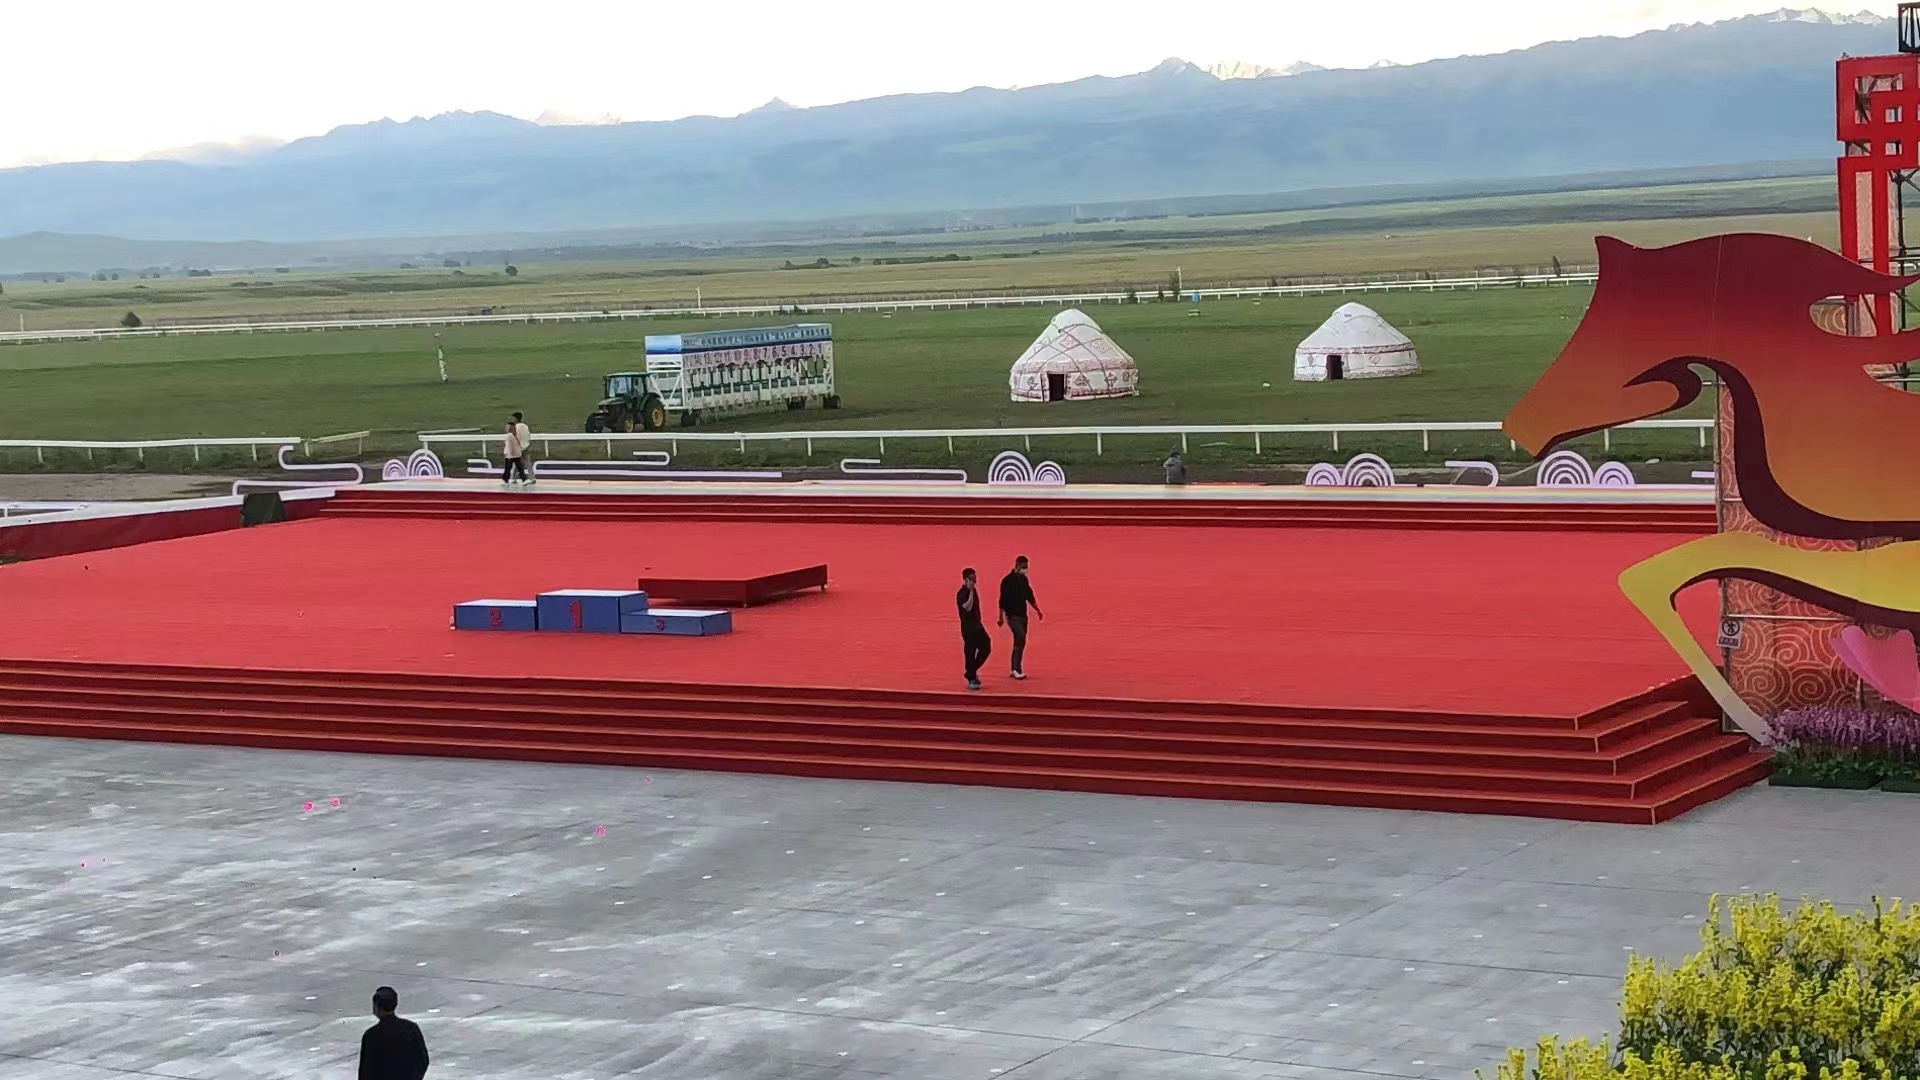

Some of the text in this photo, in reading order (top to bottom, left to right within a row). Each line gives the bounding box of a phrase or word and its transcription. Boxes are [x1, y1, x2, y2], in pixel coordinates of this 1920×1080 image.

[488, 608, 503, 626] 2
[569, 599, 583, 632] 1
[656, 618, 665, 631] 3
